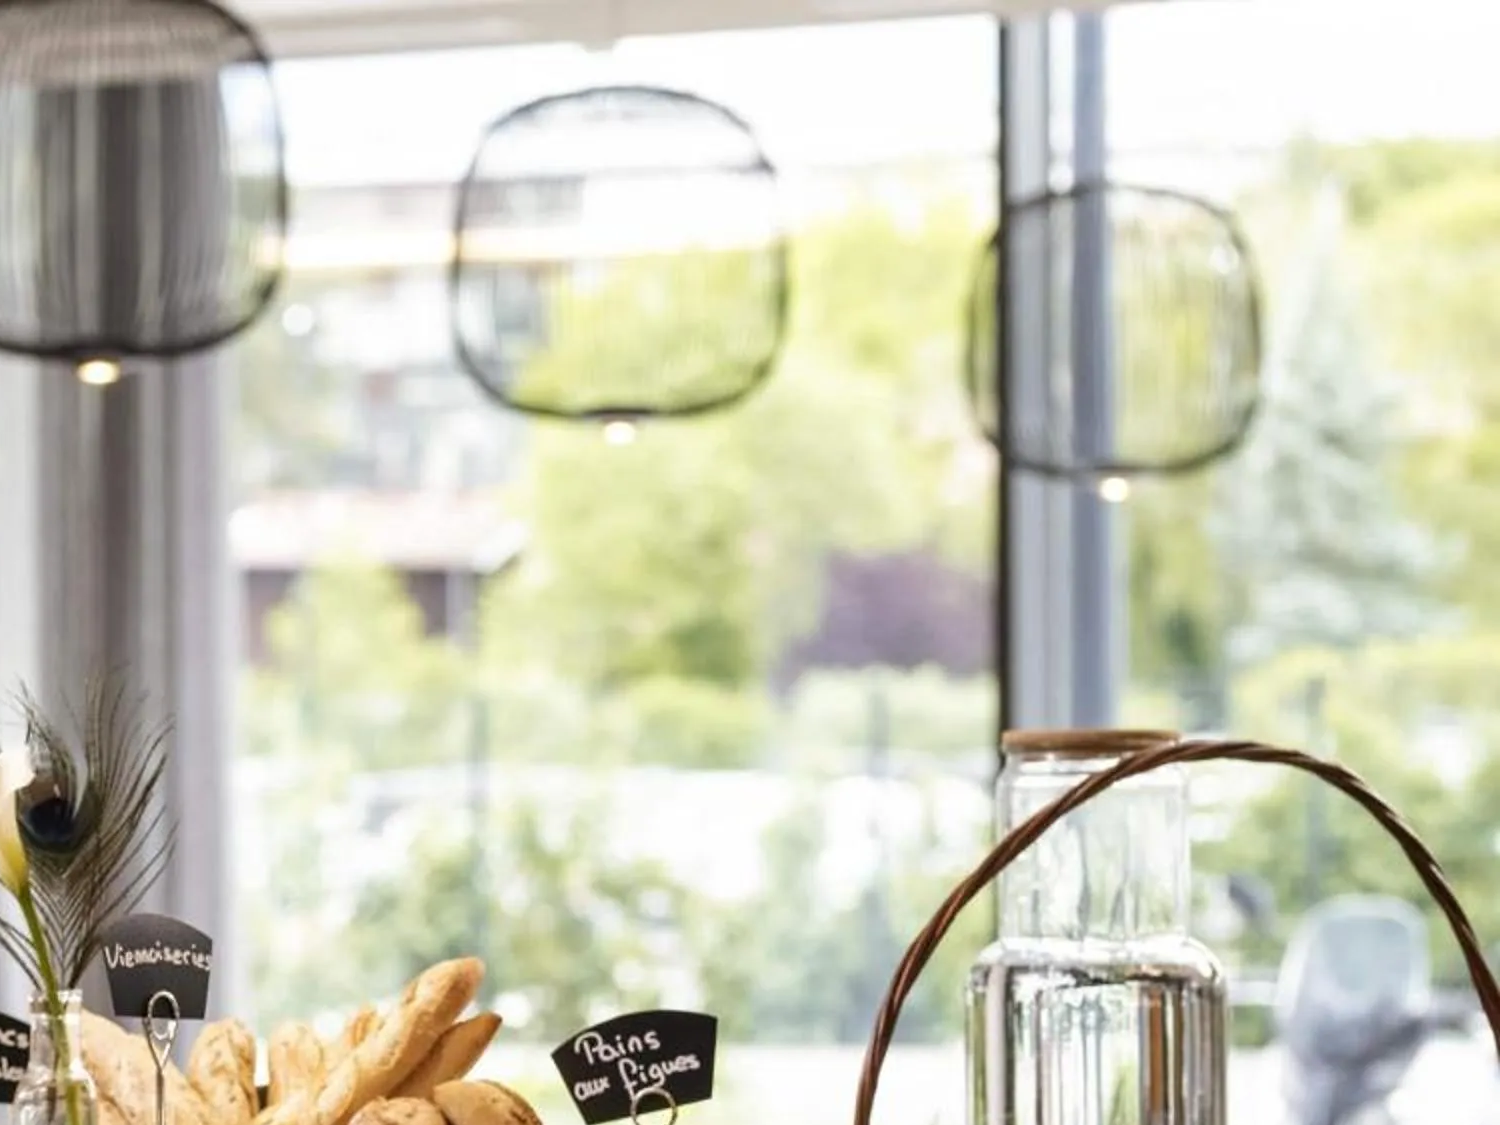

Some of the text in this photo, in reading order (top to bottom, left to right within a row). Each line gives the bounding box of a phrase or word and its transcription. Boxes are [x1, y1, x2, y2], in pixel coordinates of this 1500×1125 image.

[574, 1030, 661, 1065] Pains
[574, 1053, 701, 1101] aux figues
